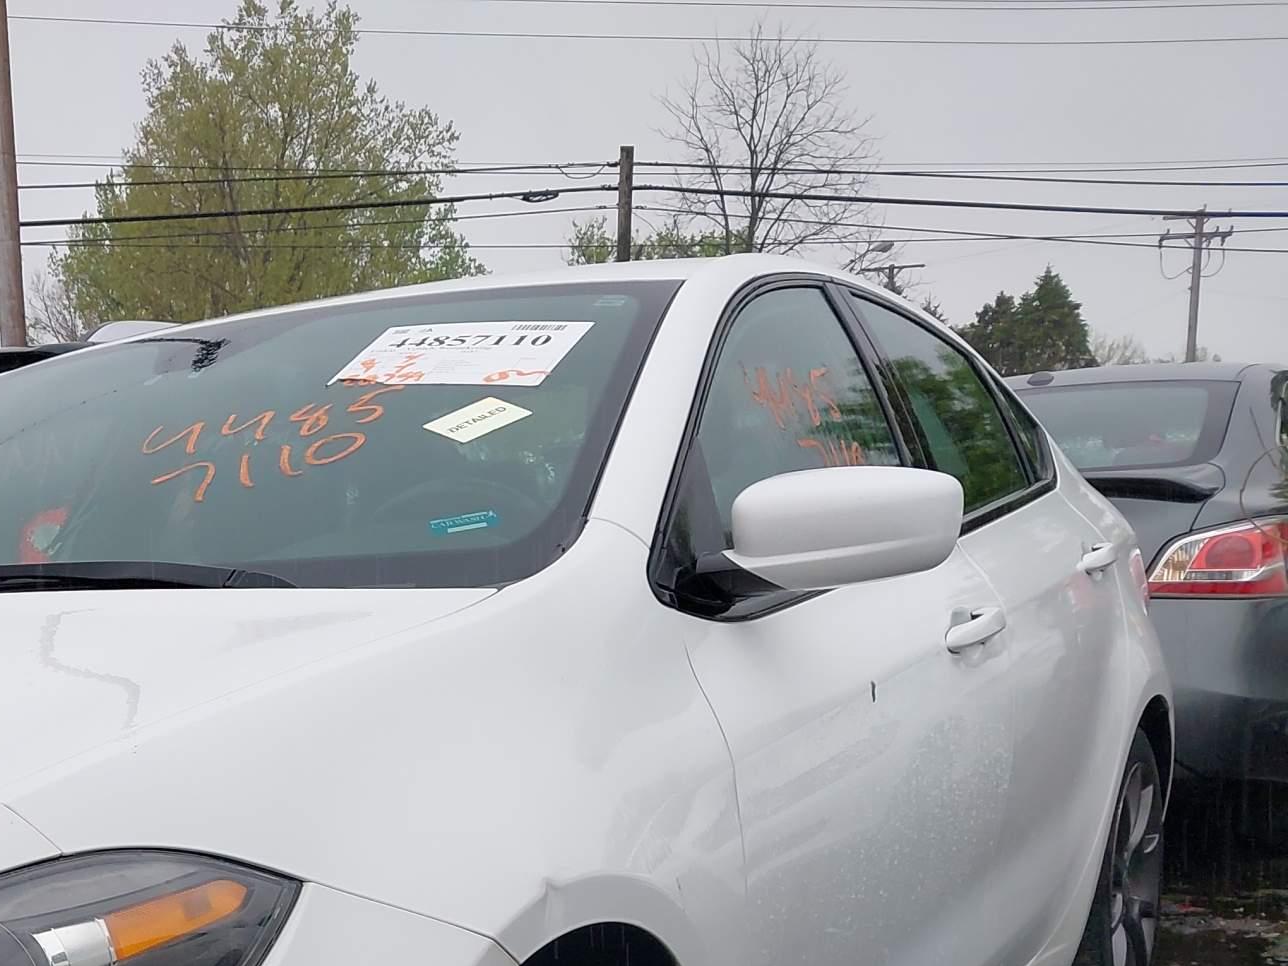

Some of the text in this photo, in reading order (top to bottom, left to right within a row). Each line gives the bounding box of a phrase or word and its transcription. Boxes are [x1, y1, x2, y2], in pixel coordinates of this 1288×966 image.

[390, 334, 552, 348] 44857110
[143, 384, 406, 453] 4485
[448, 406, 507, 433] DETAILED
[151, 432, 366, 502] 7110
